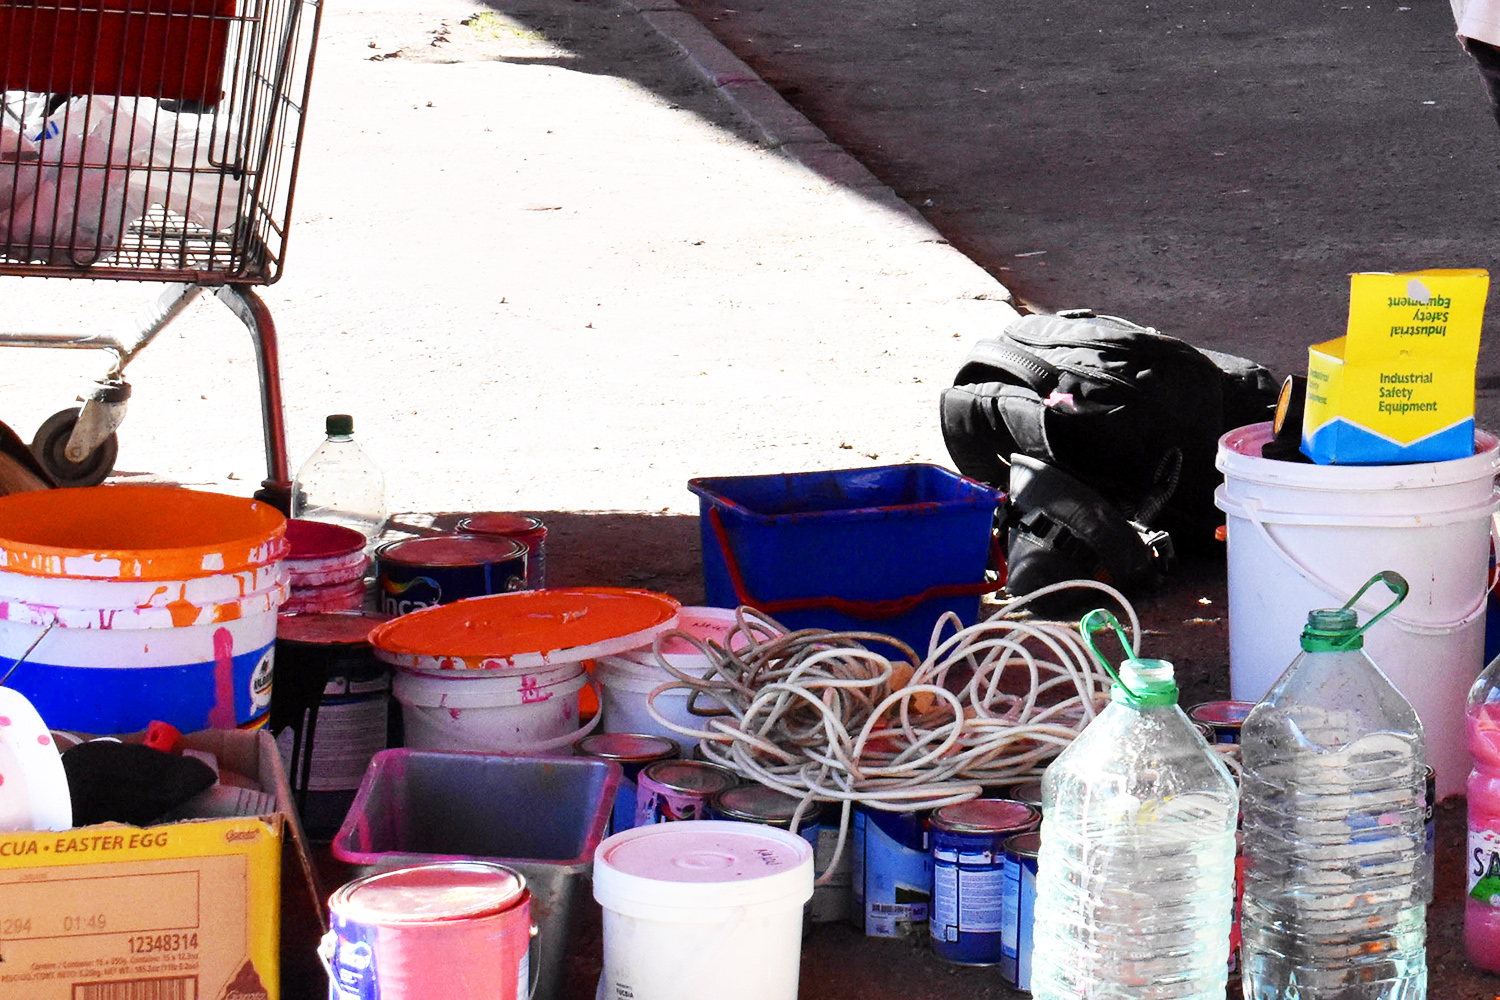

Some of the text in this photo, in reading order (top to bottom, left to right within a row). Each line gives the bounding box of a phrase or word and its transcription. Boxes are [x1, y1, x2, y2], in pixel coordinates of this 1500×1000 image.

[1413, 308, 1449, 323] Safety
[1390, 325, 1446, 337] Industrial
[1380, 372, 1433, 384] Industrial
[1379, 386, 1413, 399] Safety
[1378, 401, 1438, 415] Equipment
[55, 835, 124, 853] EASTER
[129, 832, 168, 849] EGG
[63, 913, 107, 932] 01:49
[128, 933, 198, 953] 12348314
